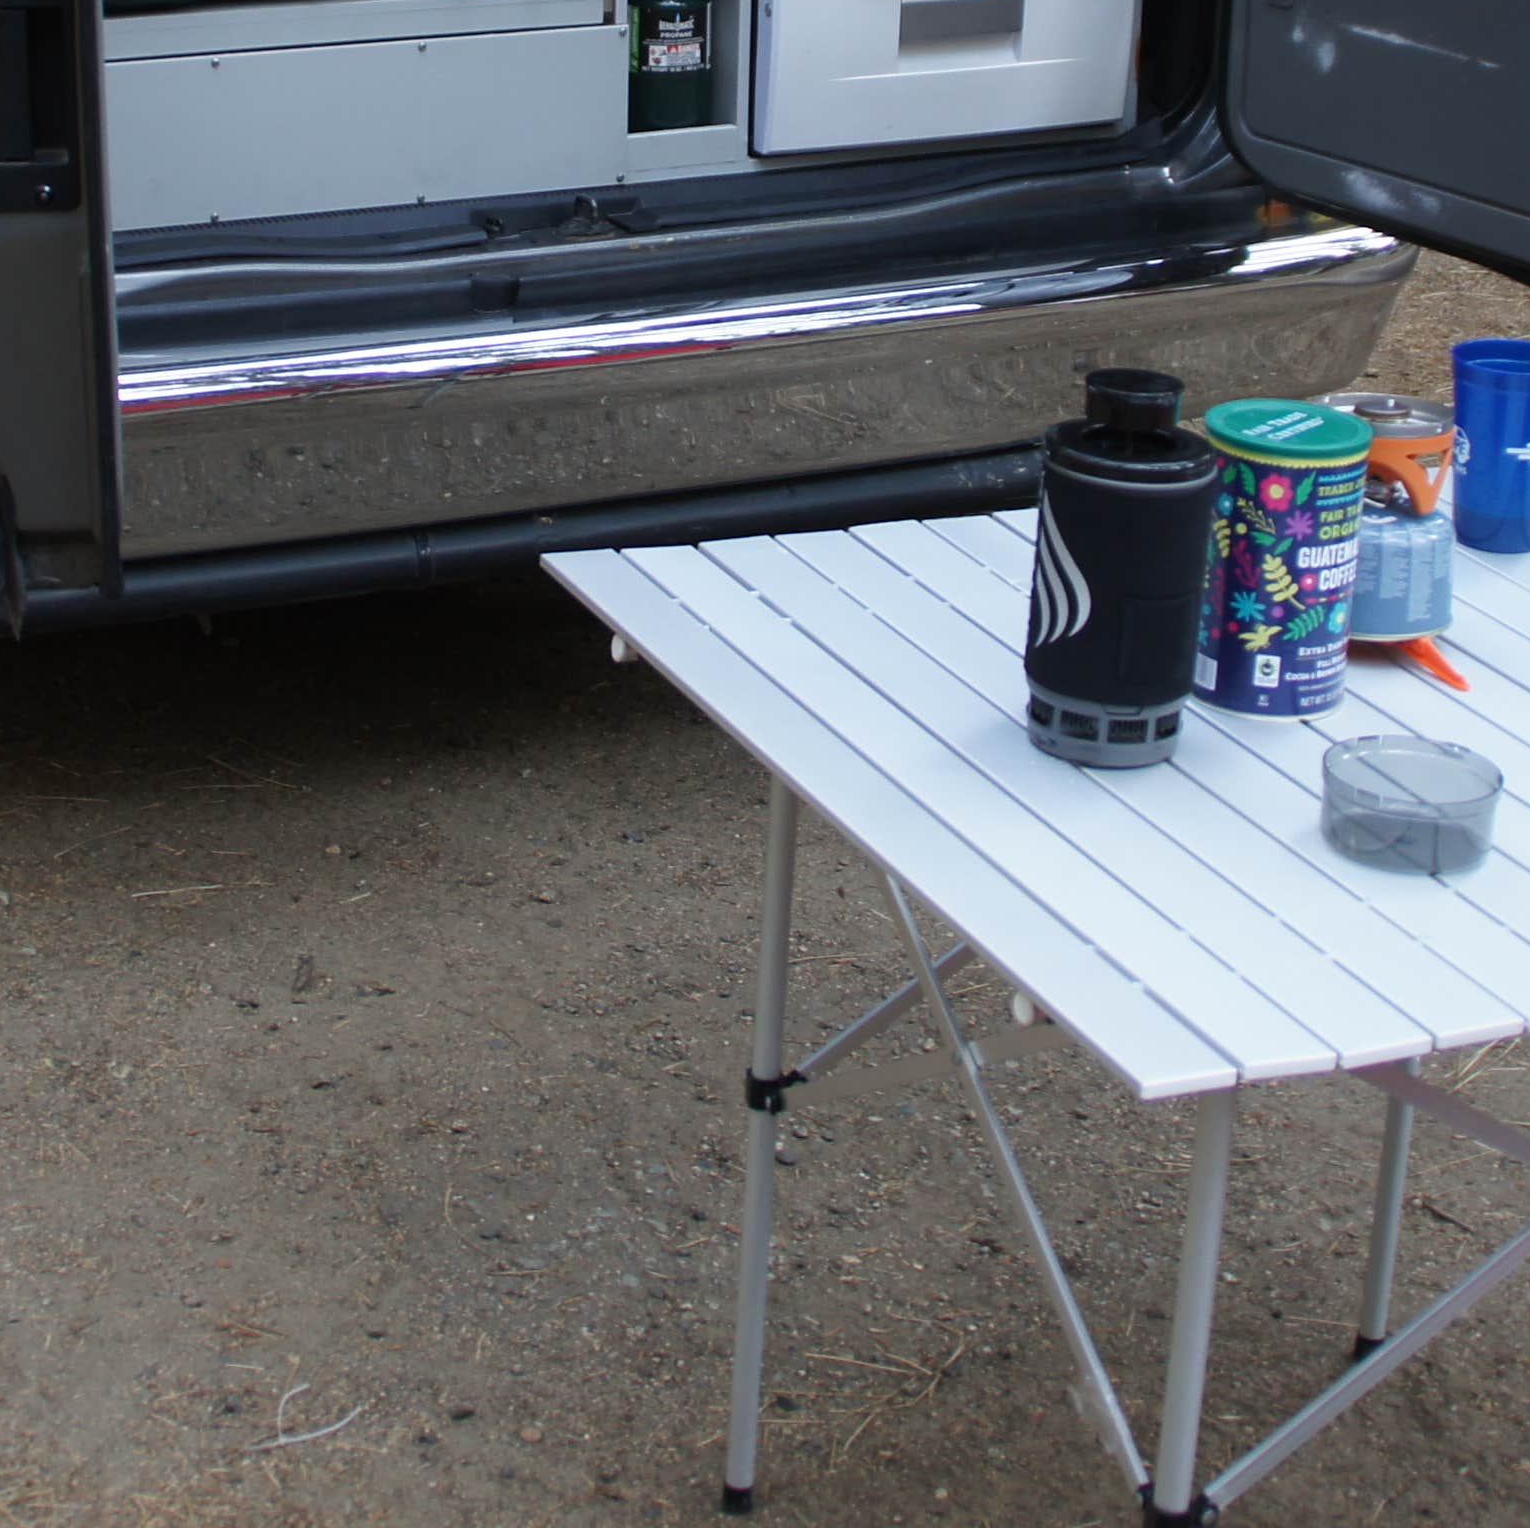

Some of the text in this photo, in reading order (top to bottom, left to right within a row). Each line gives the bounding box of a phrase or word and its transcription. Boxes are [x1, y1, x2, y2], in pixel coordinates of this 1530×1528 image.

[660, 31, 692, 39] PROPANE
[1320, 508, 1345, 523] FAIR
[1319, 558, 1358, 590] COFFE
